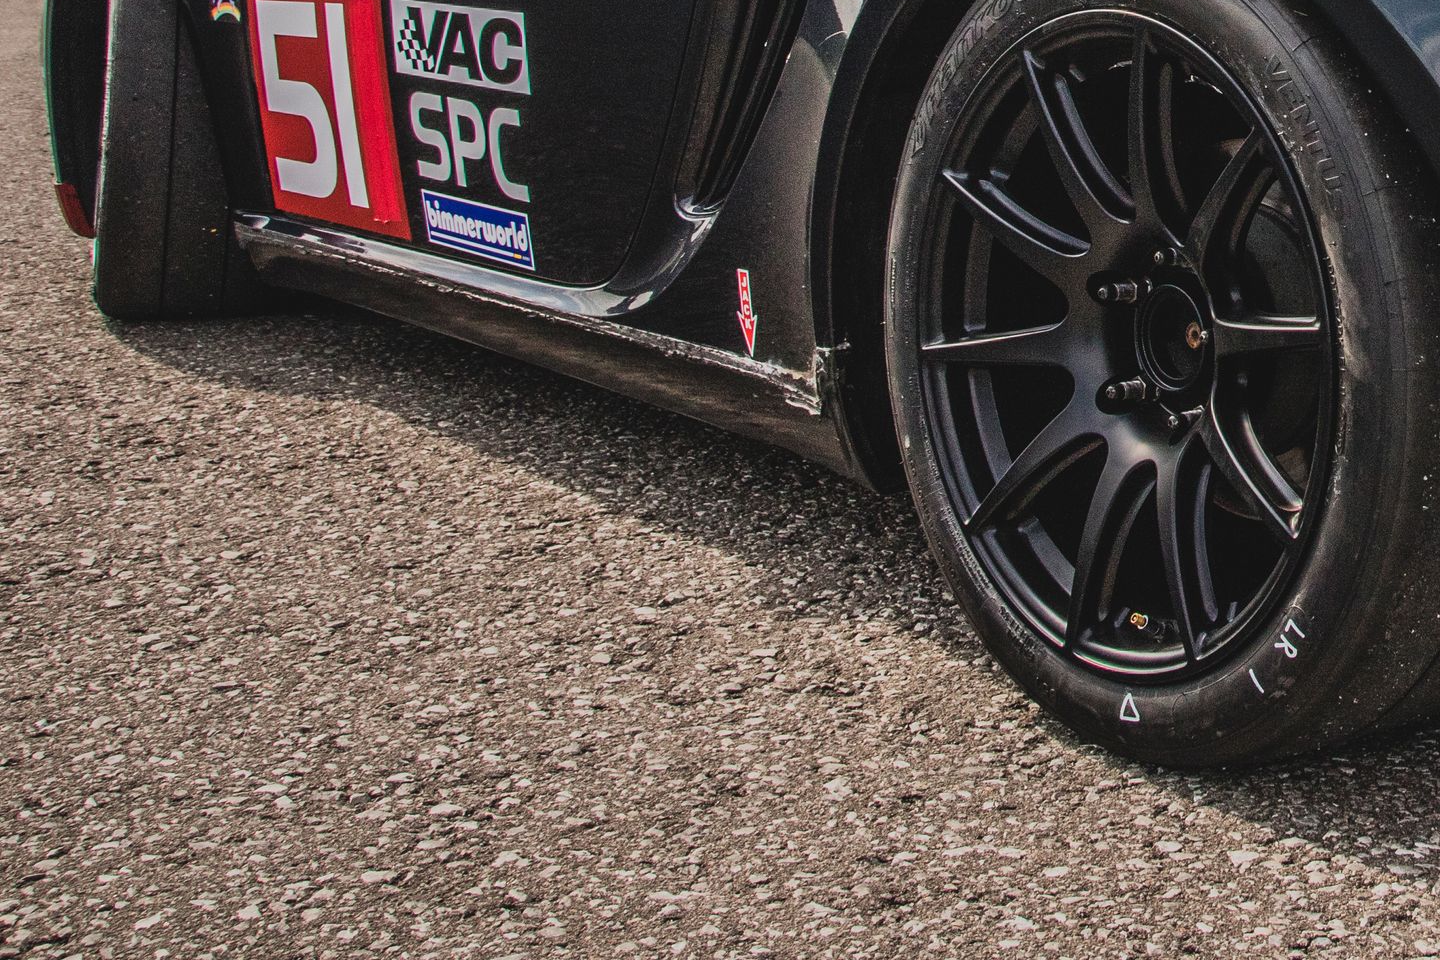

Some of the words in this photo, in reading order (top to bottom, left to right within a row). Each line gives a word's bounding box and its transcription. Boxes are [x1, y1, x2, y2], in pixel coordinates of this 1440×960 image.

[397, 6, 523, 85] VAC
[255, 0, 370, 209] 51
[410, 91, 530, 203] SPC
[425, 200, 529, 252] bimmerworld
[741, 276, 752, 330] JACK
